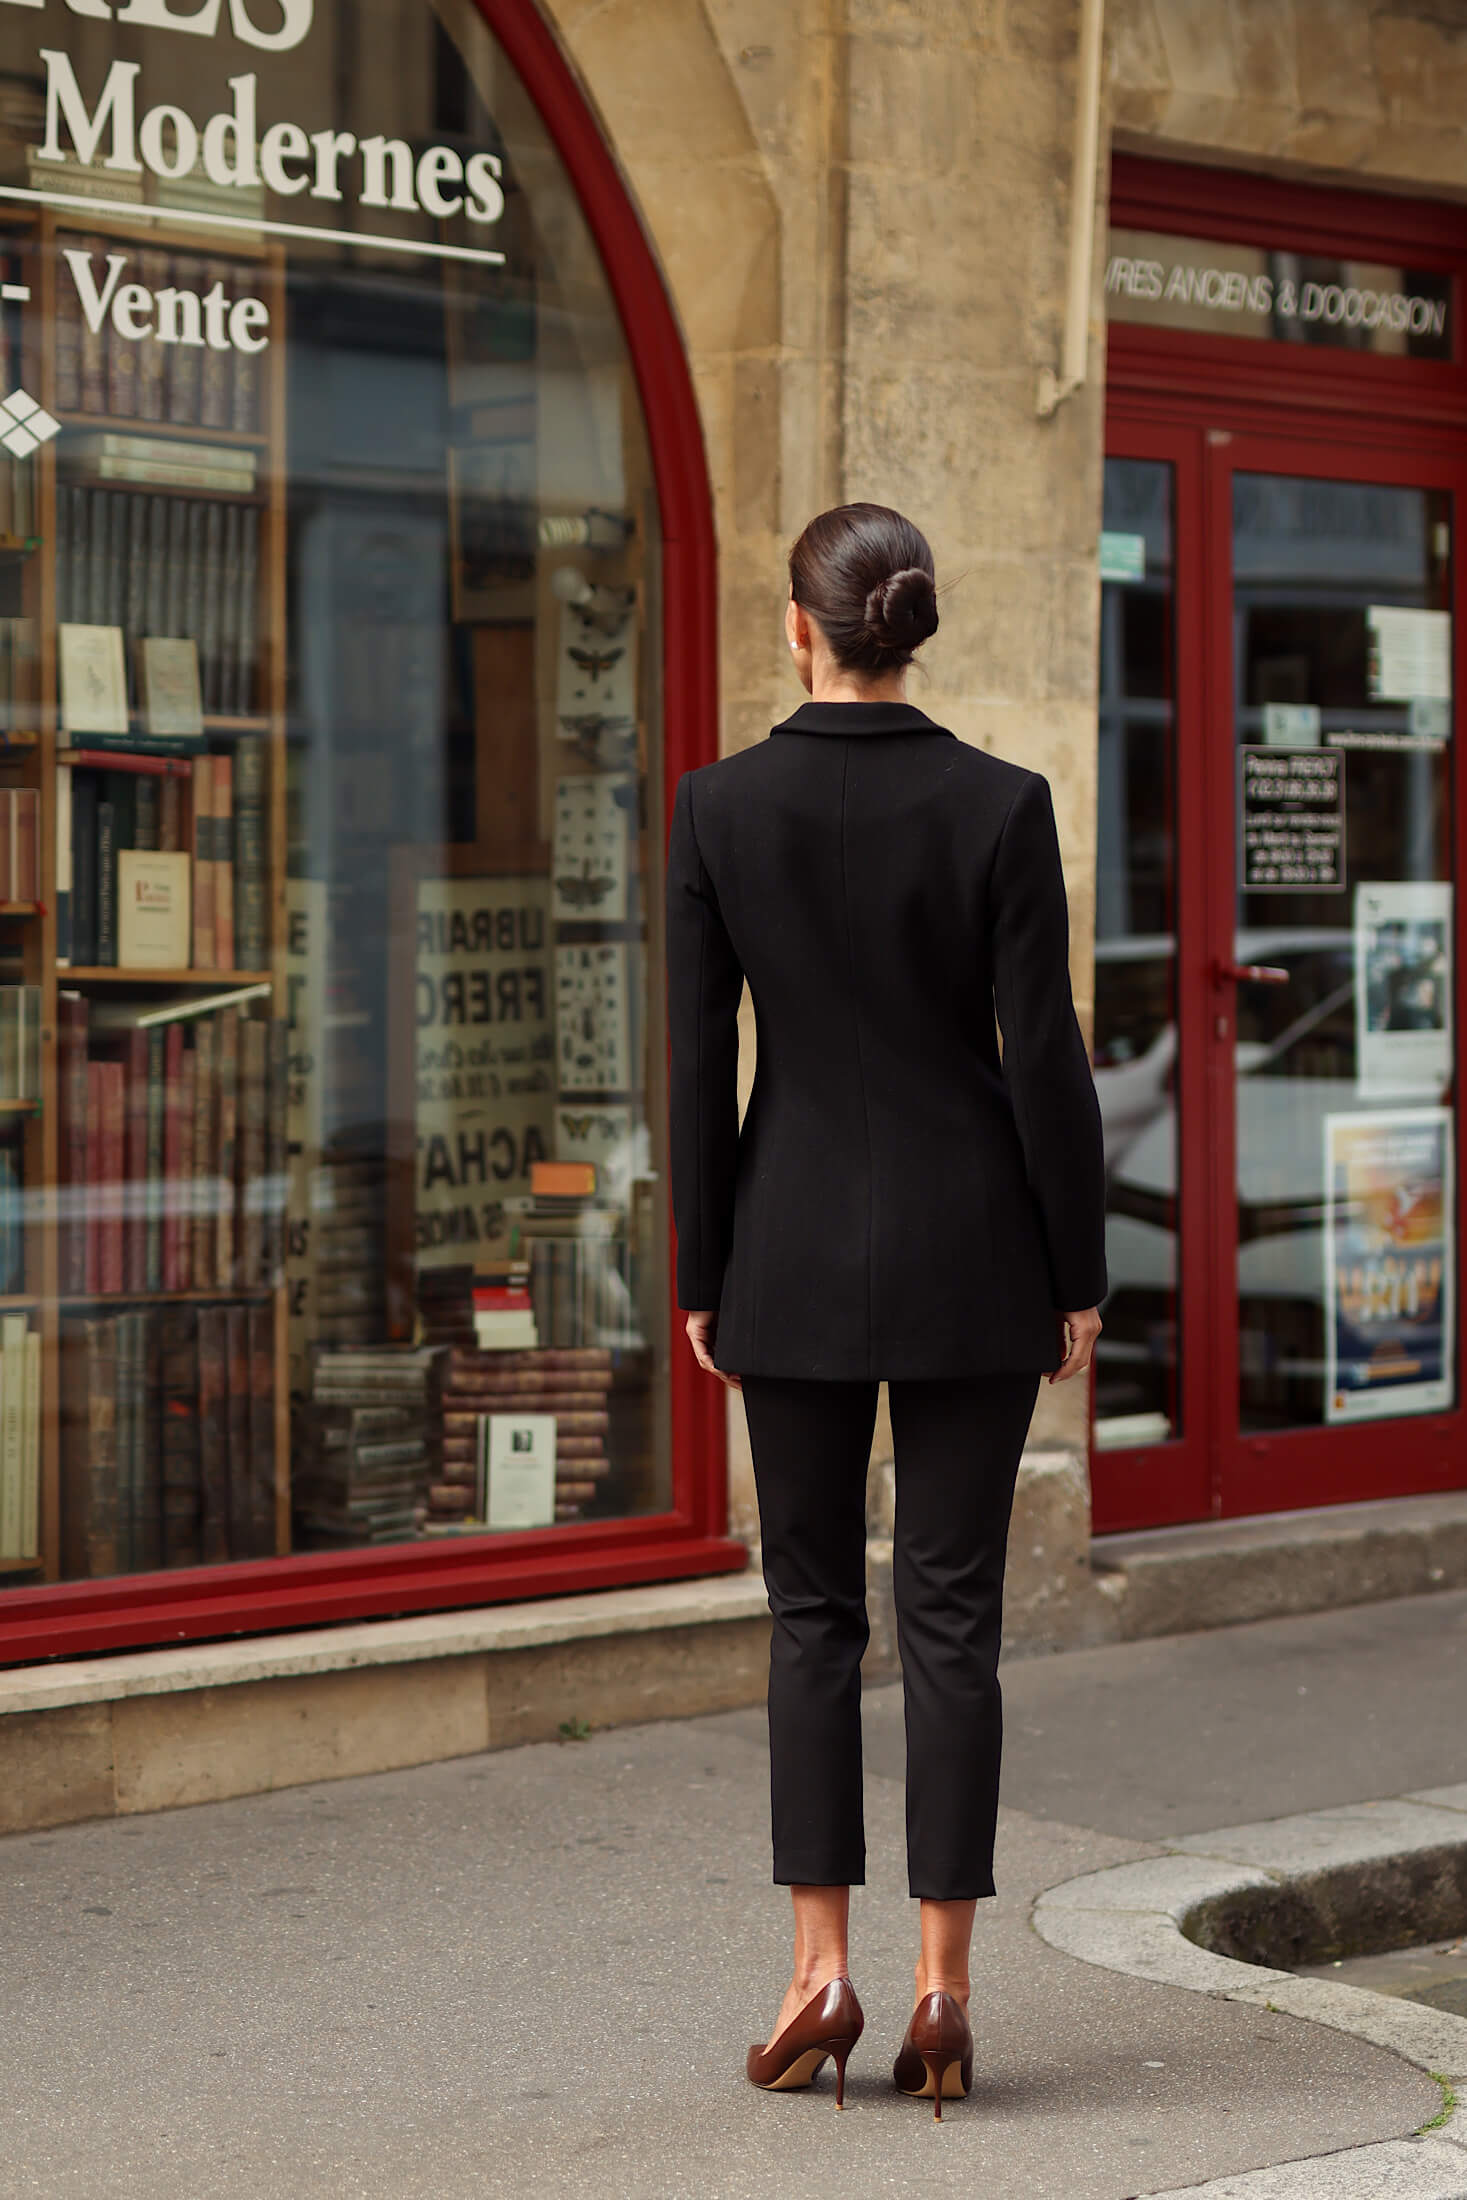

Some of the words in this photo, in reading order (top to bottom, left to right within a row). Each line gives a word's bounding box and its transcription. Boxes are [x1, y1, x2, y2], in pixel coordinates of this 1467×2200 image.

[37, 48, 504, 224] Modernes
[63, 249, 270, 353] Vente
[1276, 279, 1298, 317] &
